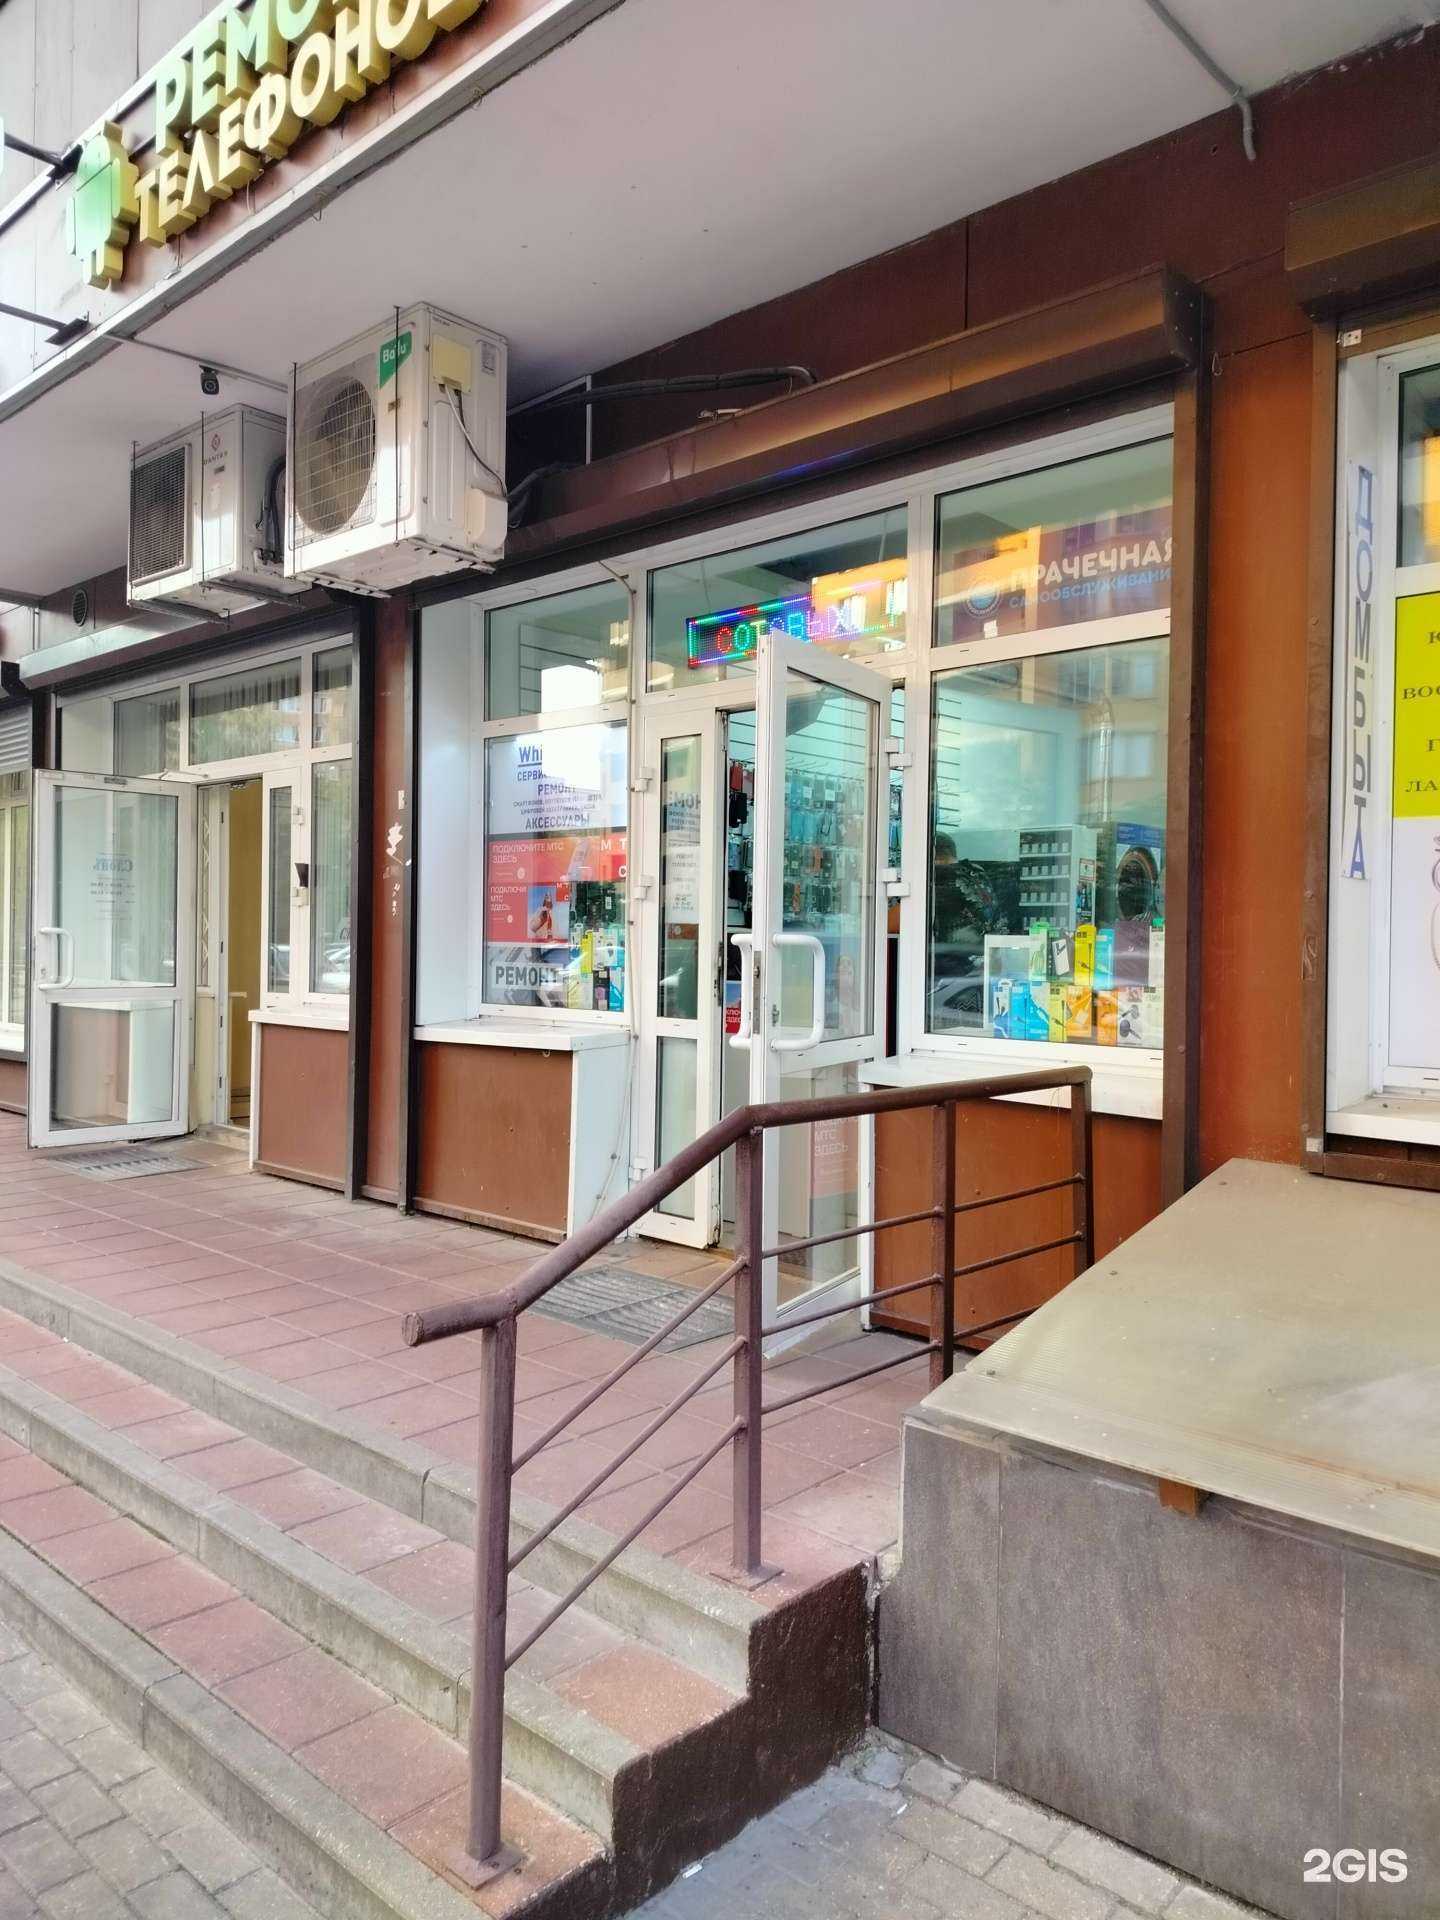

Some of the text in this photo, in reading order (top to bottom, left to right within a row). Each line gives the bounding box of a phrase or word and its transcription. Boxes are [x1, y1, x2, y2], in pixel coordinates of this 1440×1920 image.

[134, 0, 472, 247] ТЕЛЕФОНО
[154, 0, 338, 155] РЕМО
[517, 769, 548, 781] СЕРВИ
